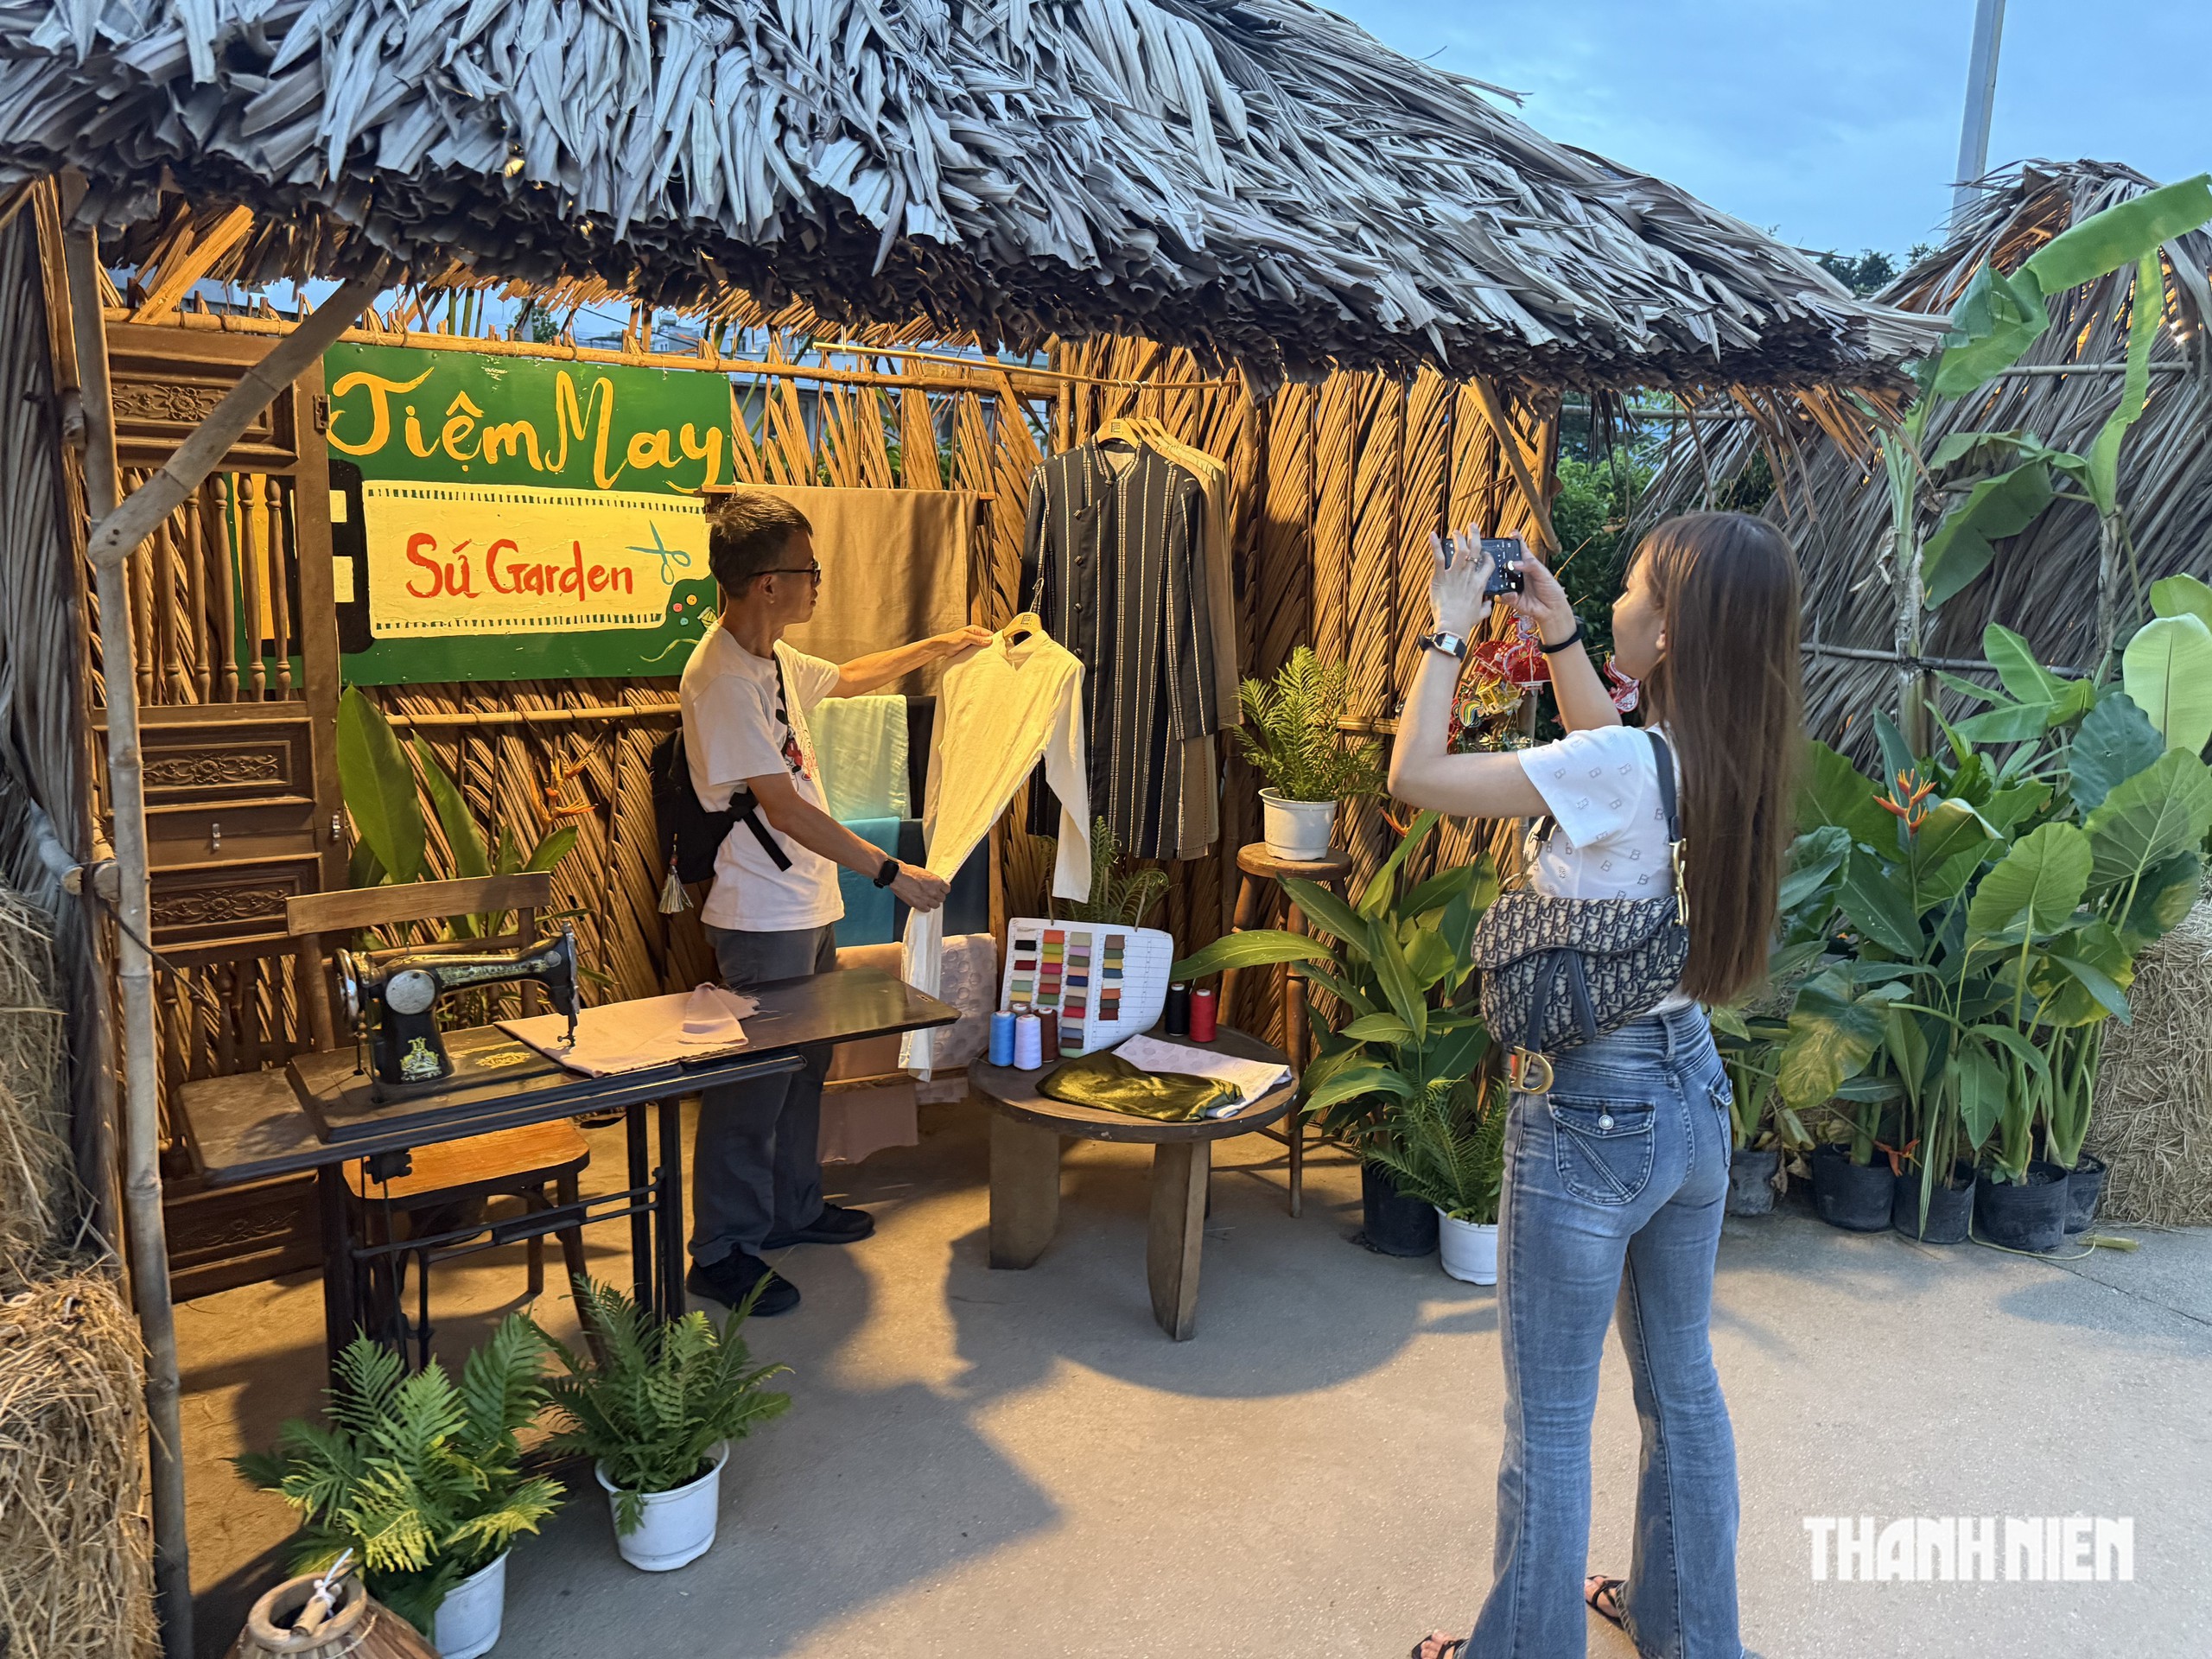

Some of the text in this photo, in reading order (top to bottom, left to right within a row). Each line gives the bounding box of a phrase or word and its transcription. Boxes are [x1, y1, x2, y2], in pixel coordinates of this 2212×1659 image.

[326, 366, 723, 493] Tiệm May
[486, 538, 633, 602] Garden
[1510, 1046, 1554, 1095] D
